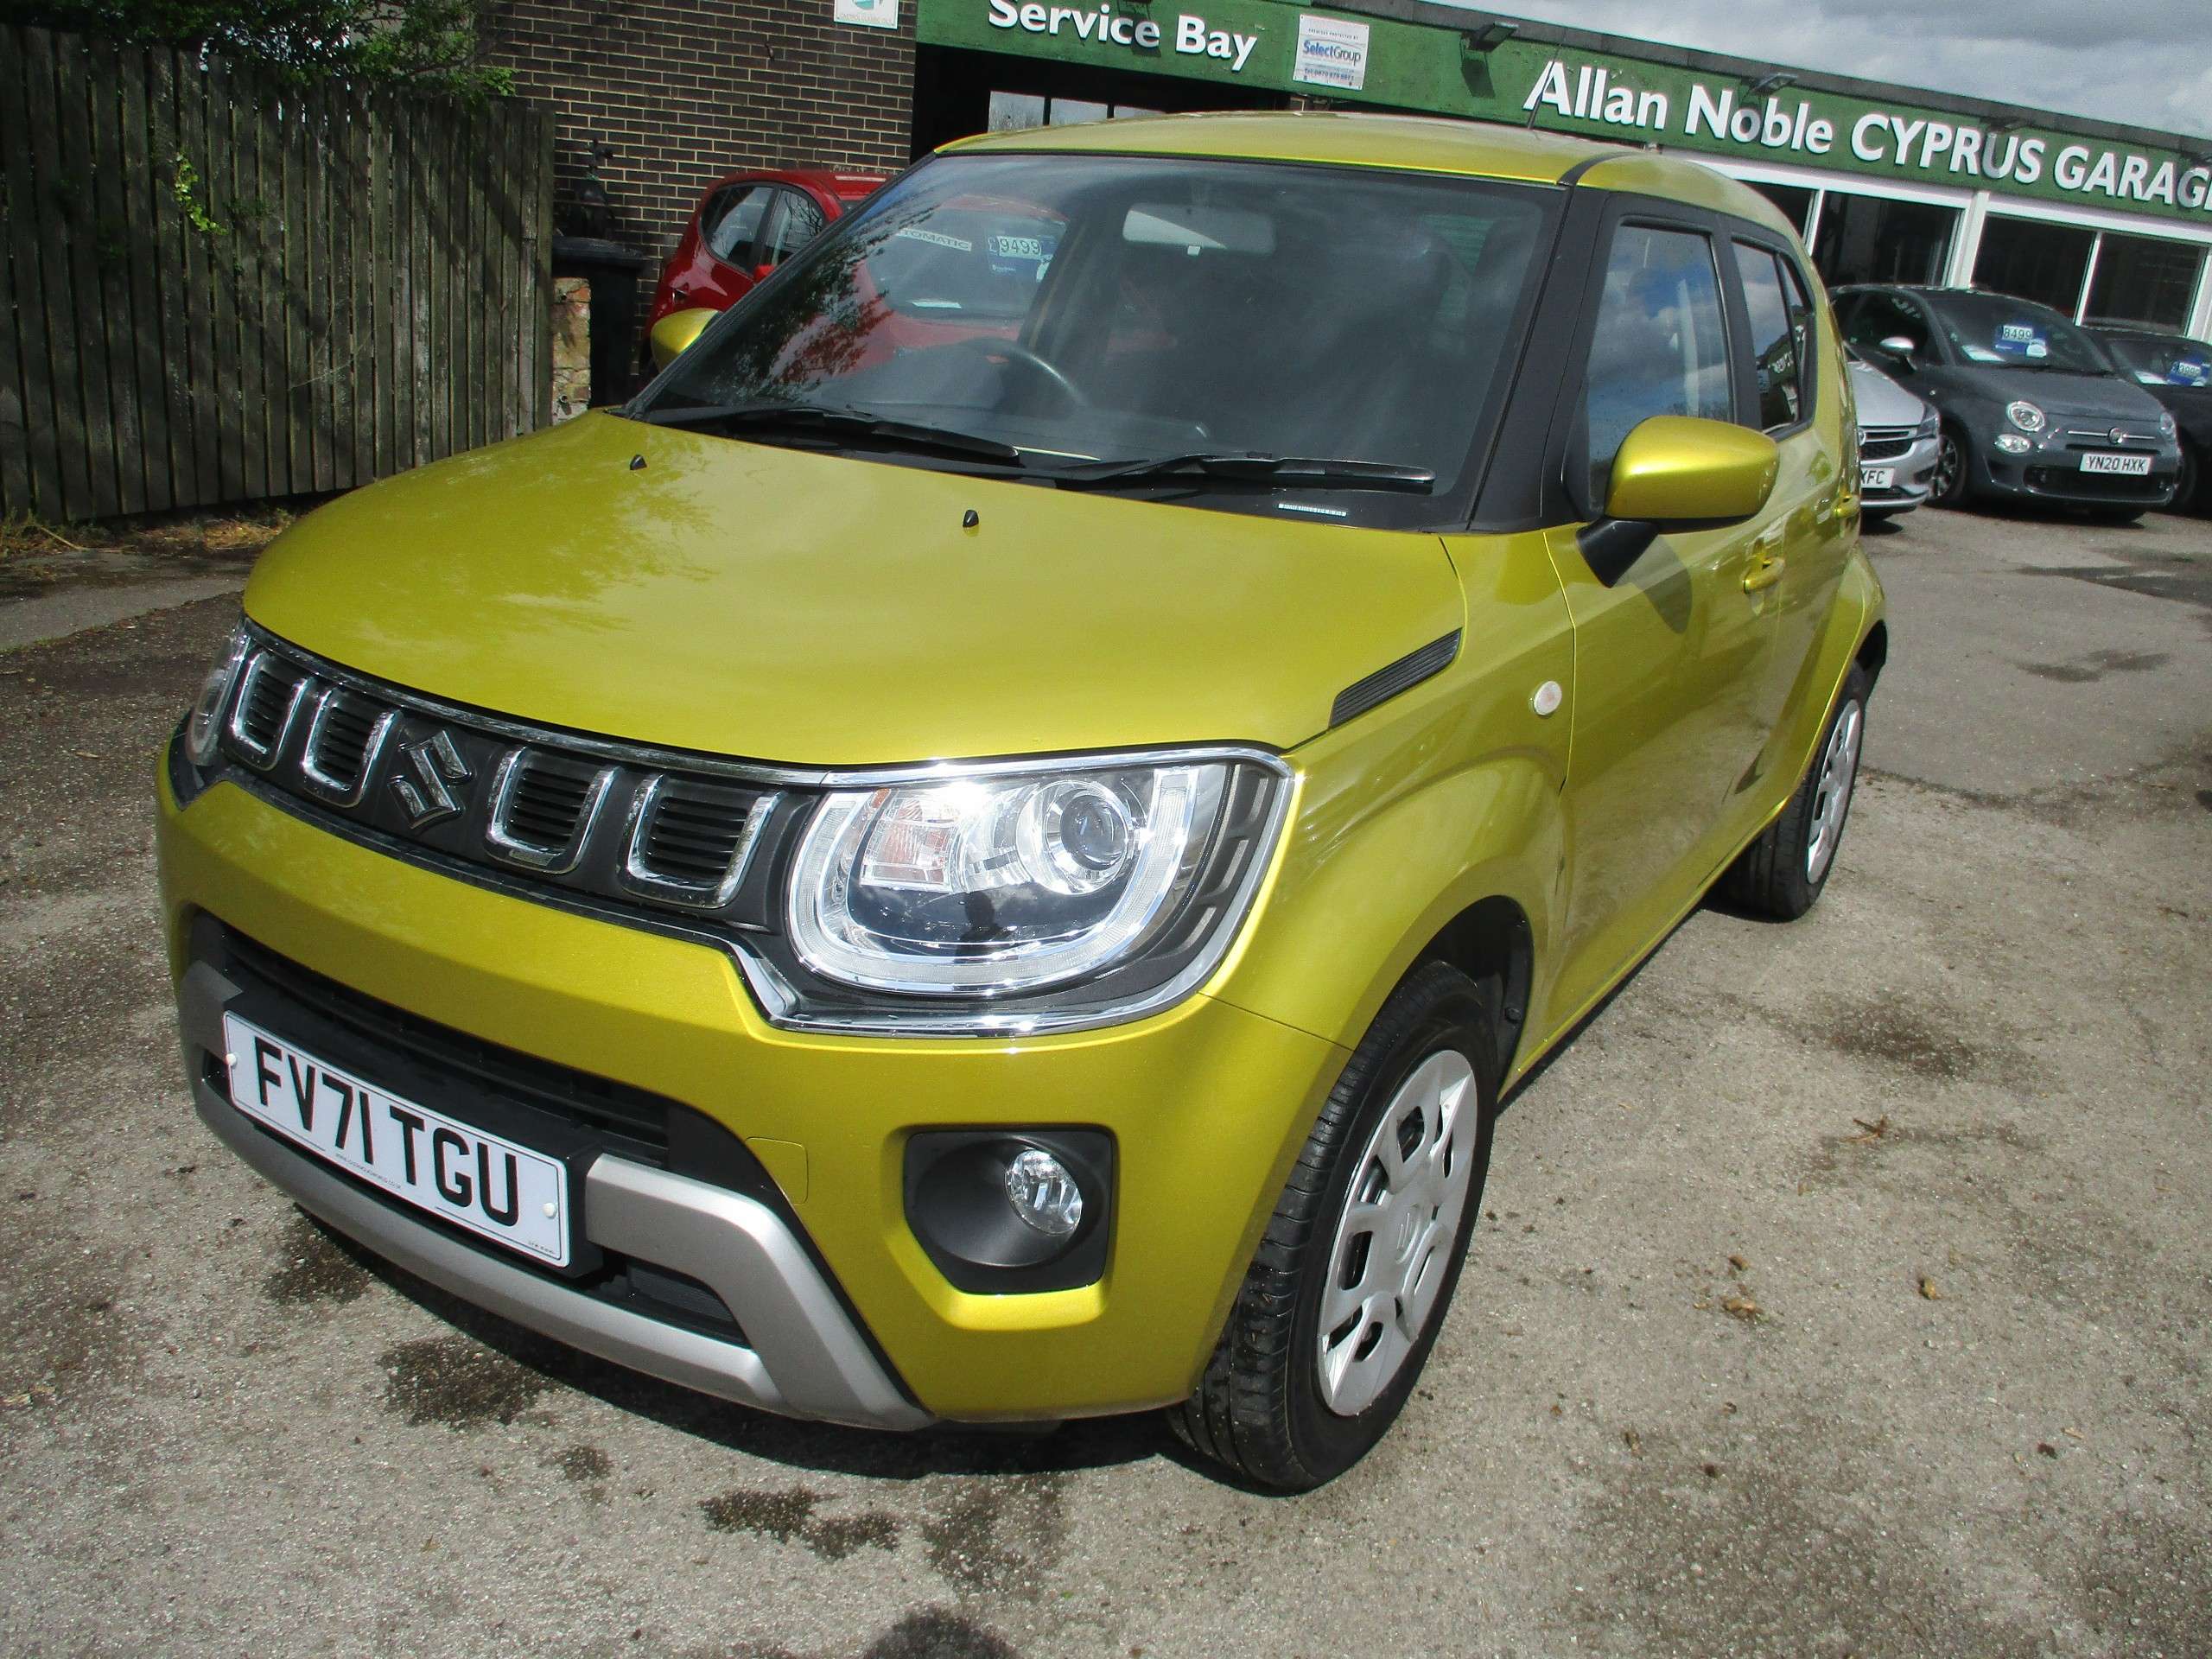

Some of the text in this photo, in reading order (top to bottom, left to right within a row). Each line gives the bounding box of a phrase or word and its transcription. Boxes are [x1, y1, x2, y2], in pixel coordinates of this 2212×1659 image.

[988, 0, 1257, 72] Service Bay
[1523, 60, 1668, 130] Allan
[1685, 85, 1833, 154] Noble
[1851, 113, 2046, 184] CYPRUS
[1001, 238, 1041, 255] 9499
[2088, 455, 2146, 473] YN20 HXK
[254, 1036, 519, 1227] FV71 TGU
